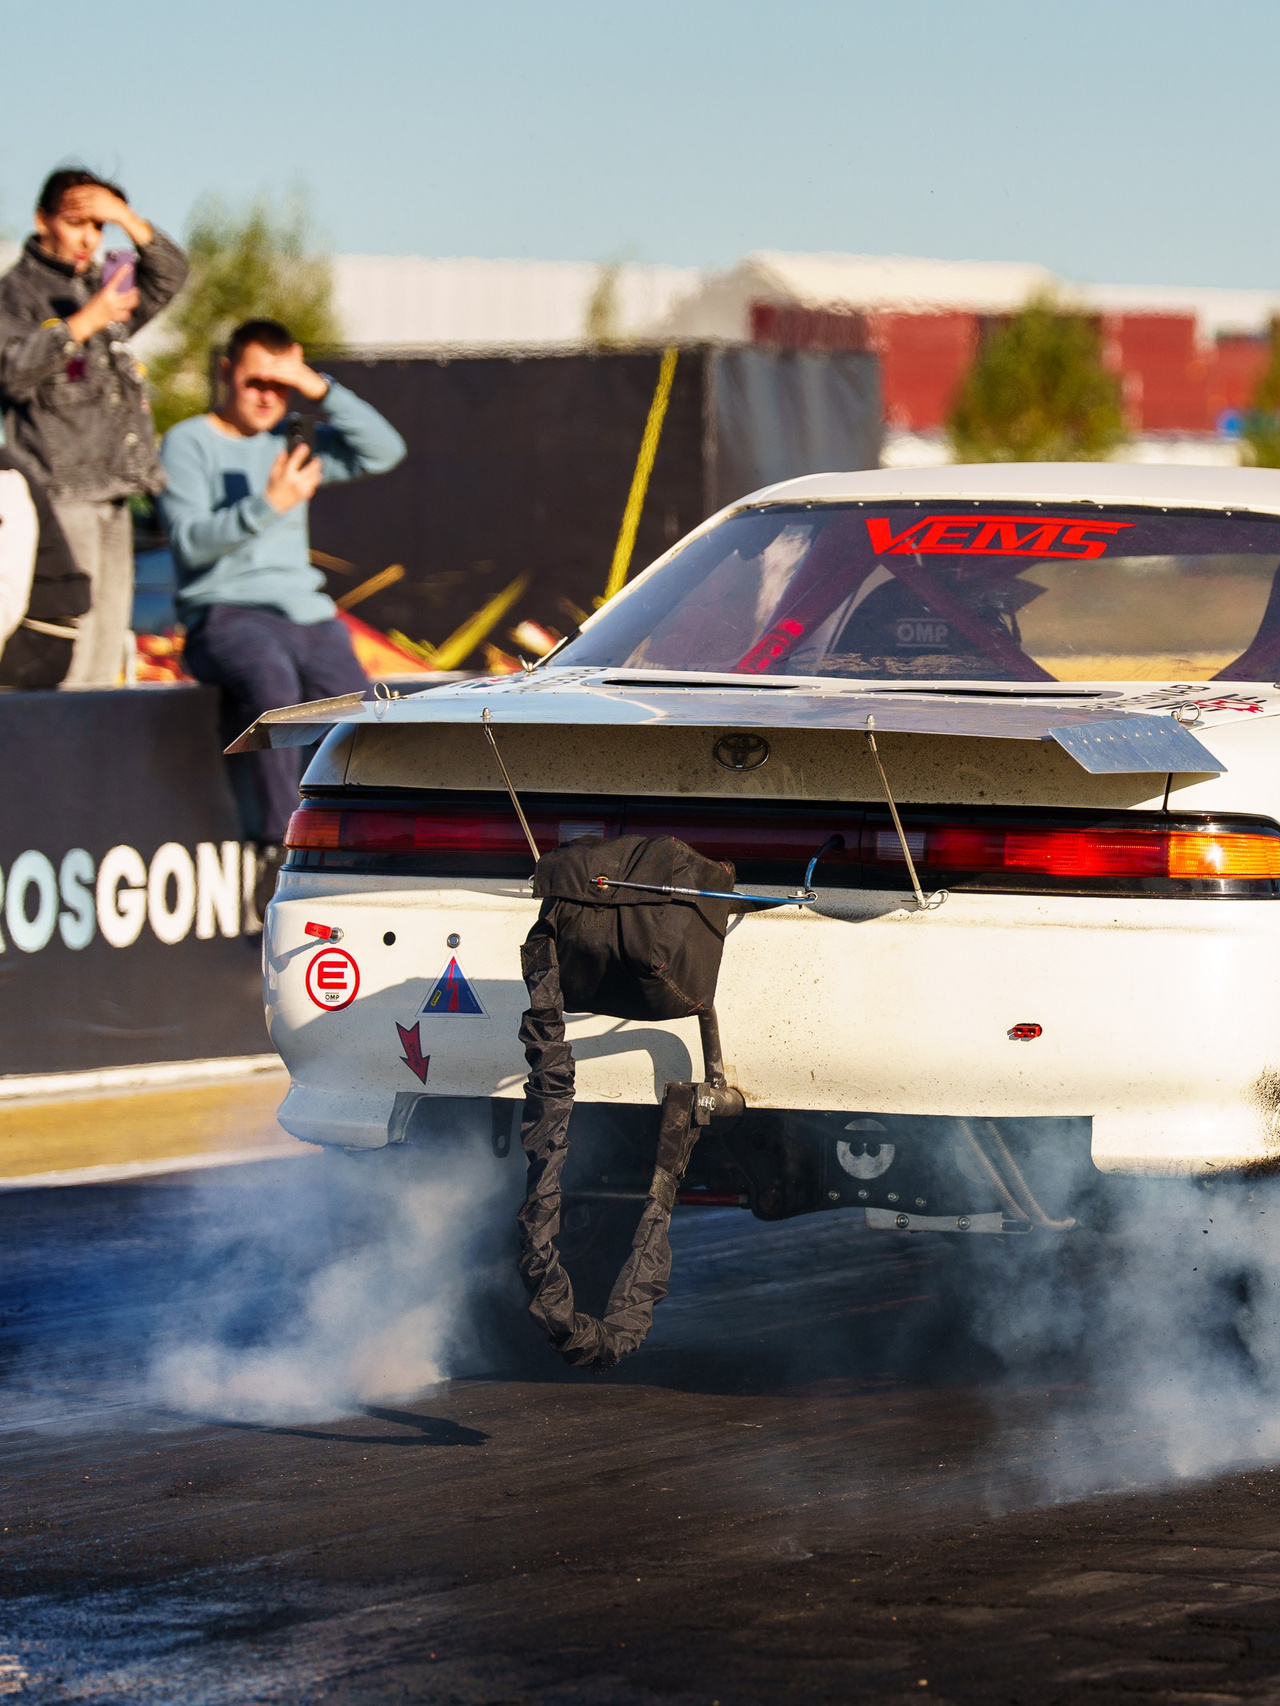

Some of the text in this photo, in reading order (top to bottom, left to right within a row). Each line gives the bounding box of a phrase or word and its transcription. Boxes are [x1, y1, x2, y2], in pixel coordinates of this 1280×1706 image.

[865, 515, 1137, 559] VEMS
[897, 622, 949, 643] OMP
[317, 961, 348, 989] E
